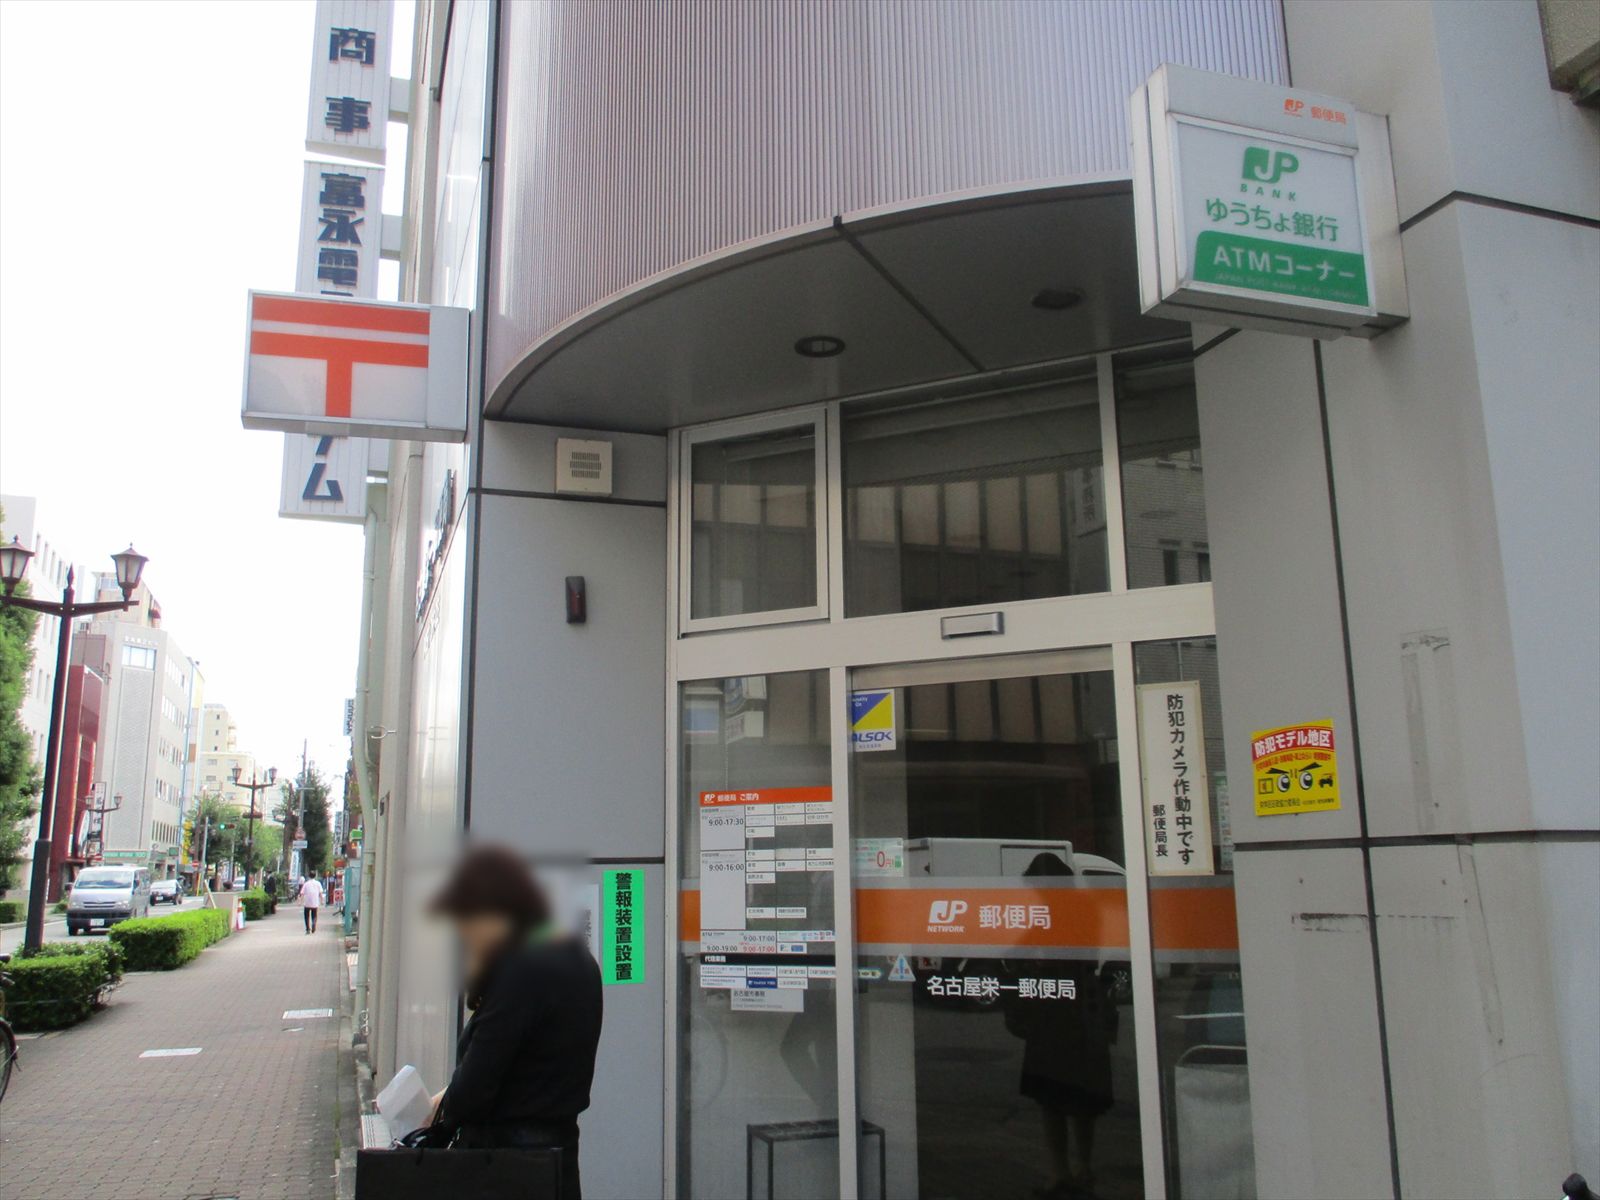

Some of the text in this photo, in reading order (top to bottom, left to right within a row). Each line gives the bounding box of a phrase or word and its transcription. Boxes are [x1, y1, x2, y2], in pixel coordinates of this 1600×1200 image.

[325, 27, 376, 133] 商事
[1242, 146, 1299, 184] JP
[1239, 183, 1296, 201] BANK
[1206, 197, 1339, 242] ゆうちょ銀行
[1213, 245, 1356, 281] ATMコーナー
[1254, 729, 1332, 759] 防犯モデル地区
[1166, 694, 1195, 865] 防犯カメラ作動中です
[1152, 804, 1169, 857] 郵便局長
[708, 863, 745, 872] 9:00-16:00
[615, 872, 633, 981] 警報装置設置
[927, 925, 965, 933] NETWORK
[928, 900, 1052, 930] JP 郵便局
[927, 975, 1077, 1000] 名古屋栄一郵便局
